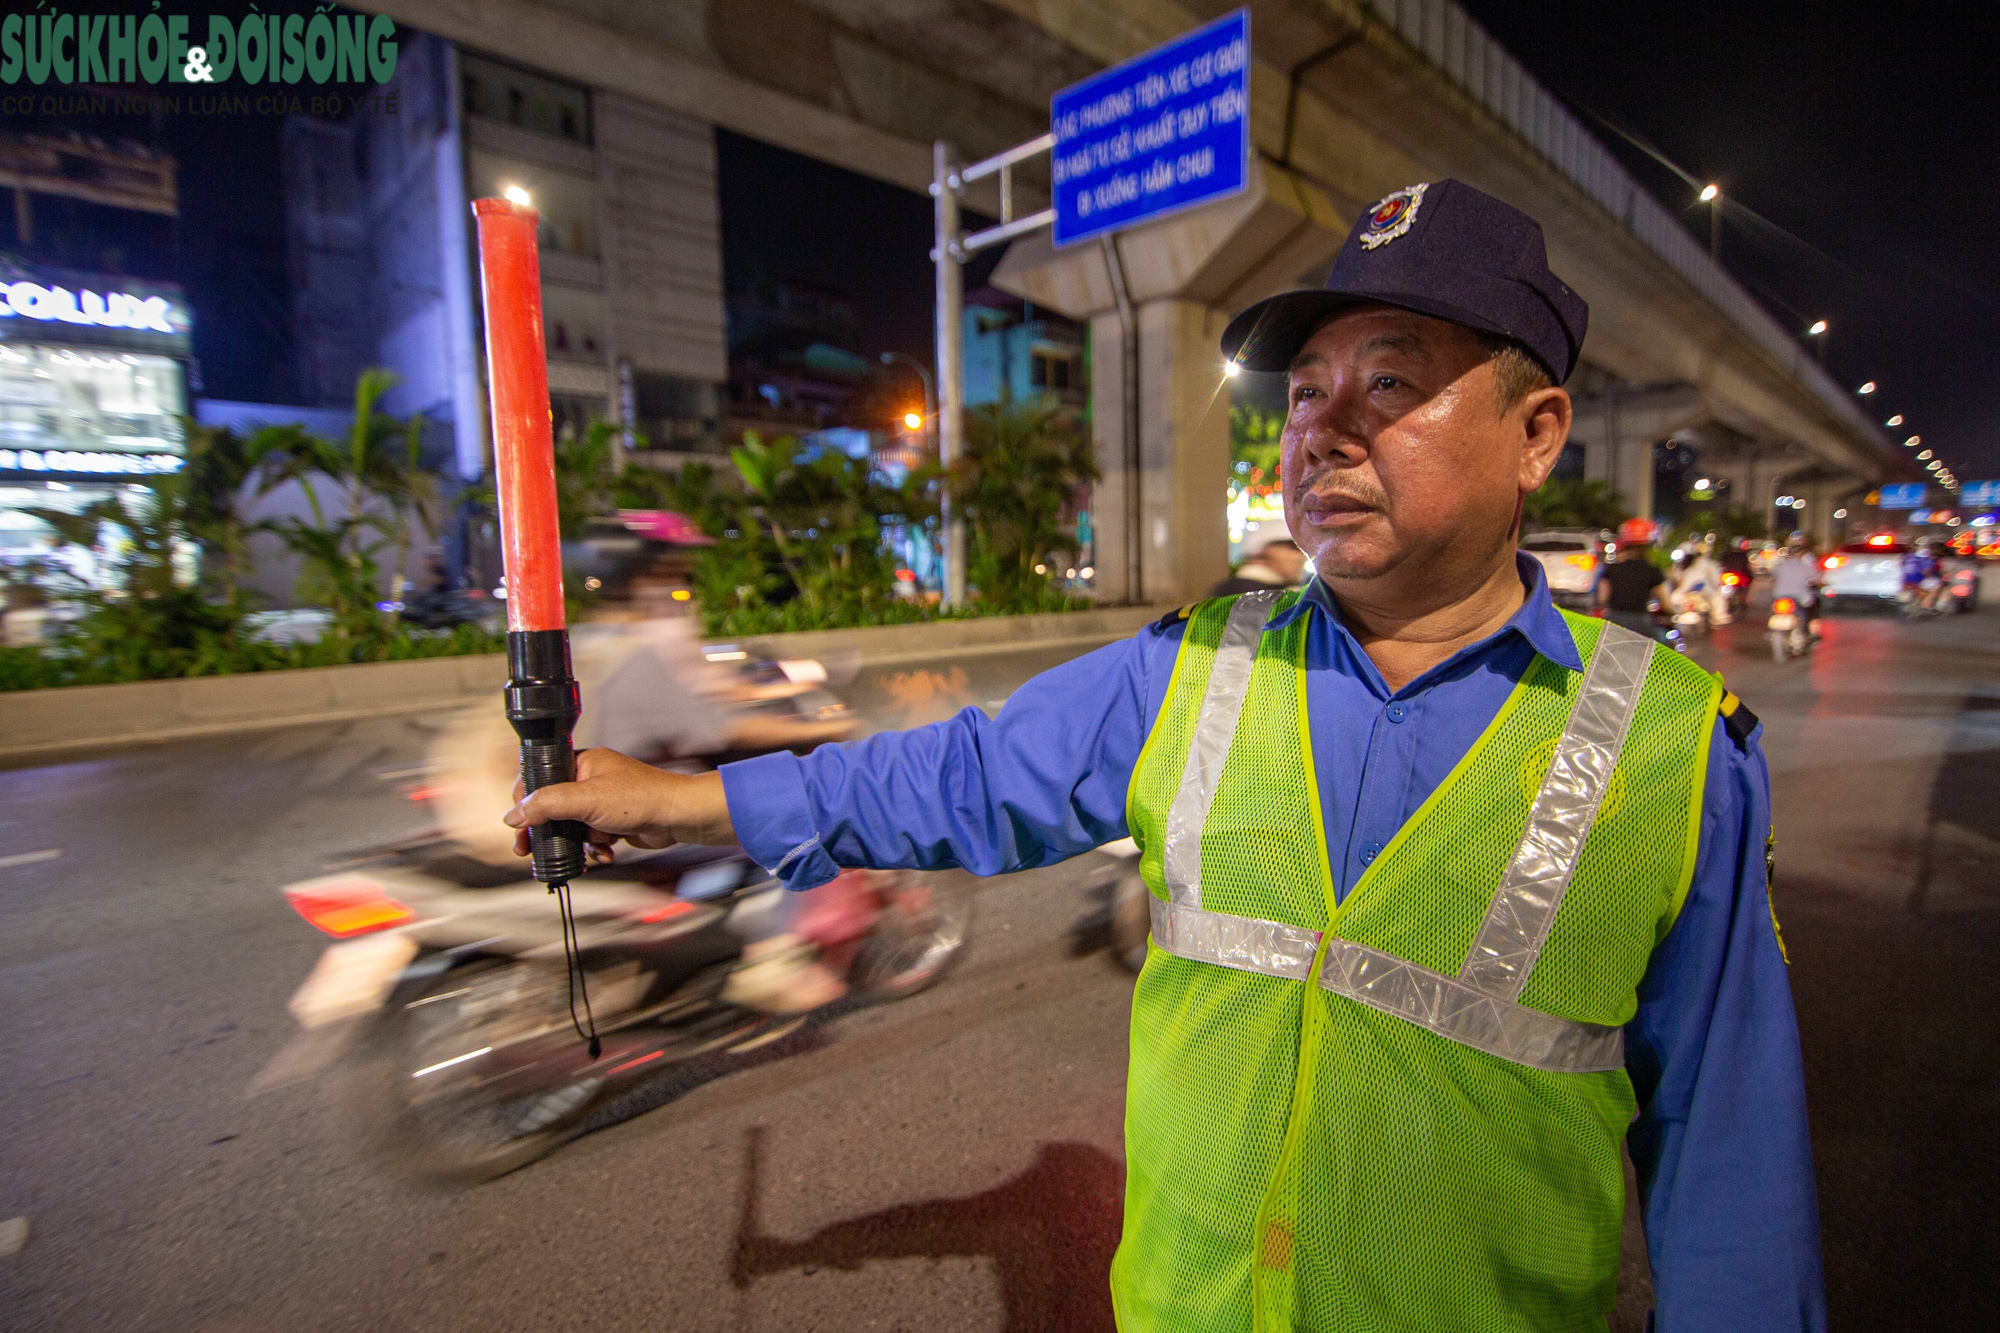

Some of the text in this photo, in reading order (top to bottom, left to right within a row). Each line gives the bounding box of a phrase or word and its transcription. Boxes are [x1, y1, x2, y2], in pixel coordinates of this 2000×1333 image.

[1168, 62, 1191, 96] XE
[1178, 99, 1209, 139] DUY
[1176, 145, 1215, 185] CHUI
